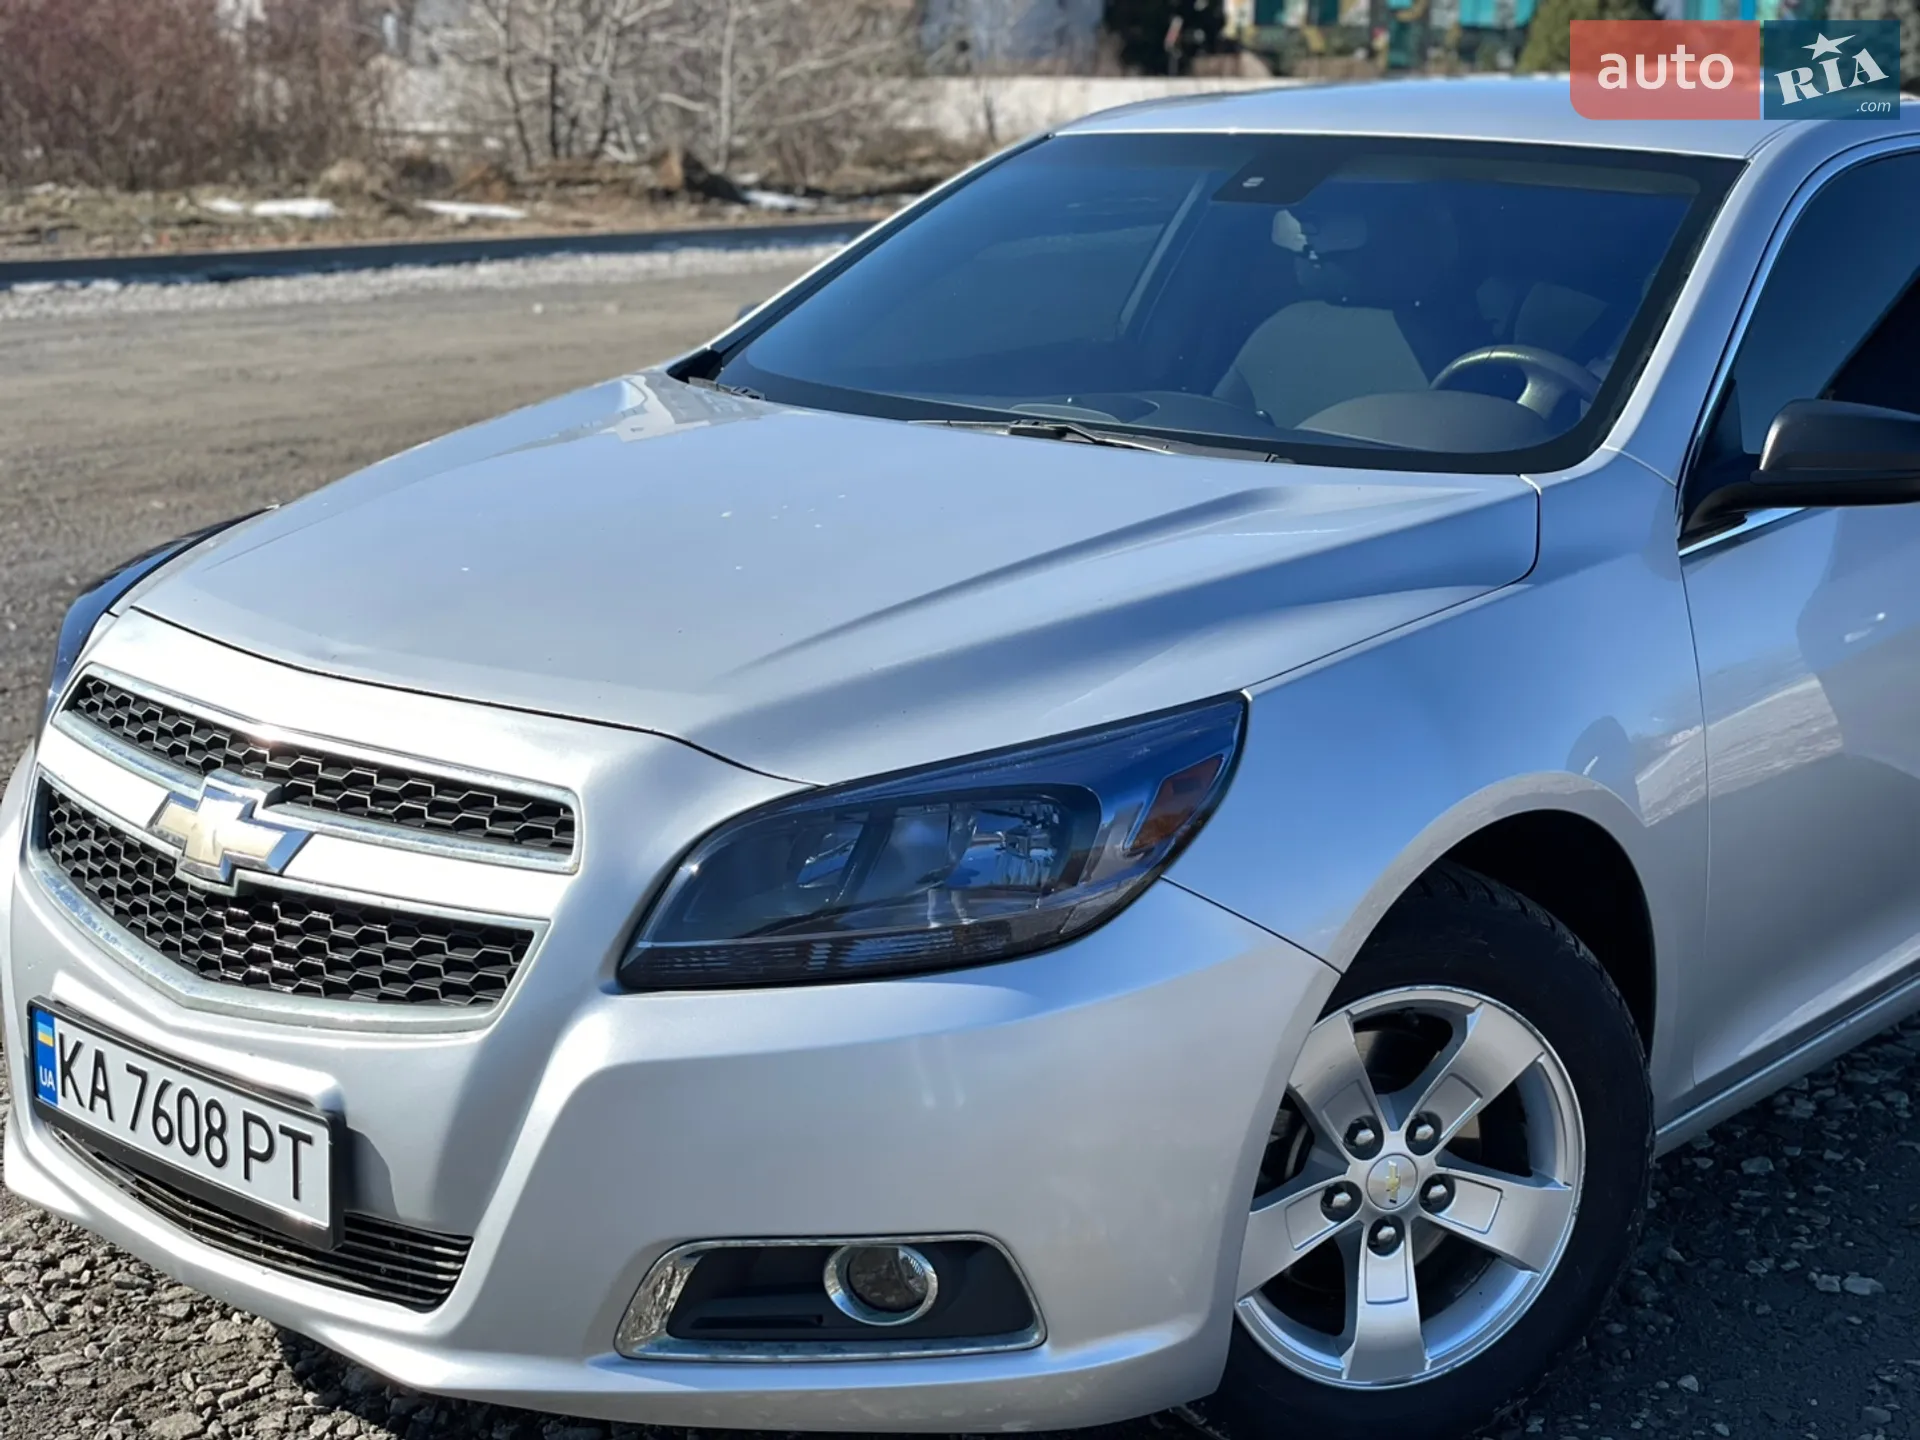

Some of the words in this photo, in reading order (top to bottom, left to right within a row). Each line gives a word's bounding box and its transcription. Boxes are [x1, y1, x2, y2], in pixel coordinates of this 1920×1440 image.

[39, 1068, 56, 1091] UA
[58, 1031, 115, 1122] KA
[125, 1062, 229, 1168] 7608
[242, 1109, 314, 1202] PT
